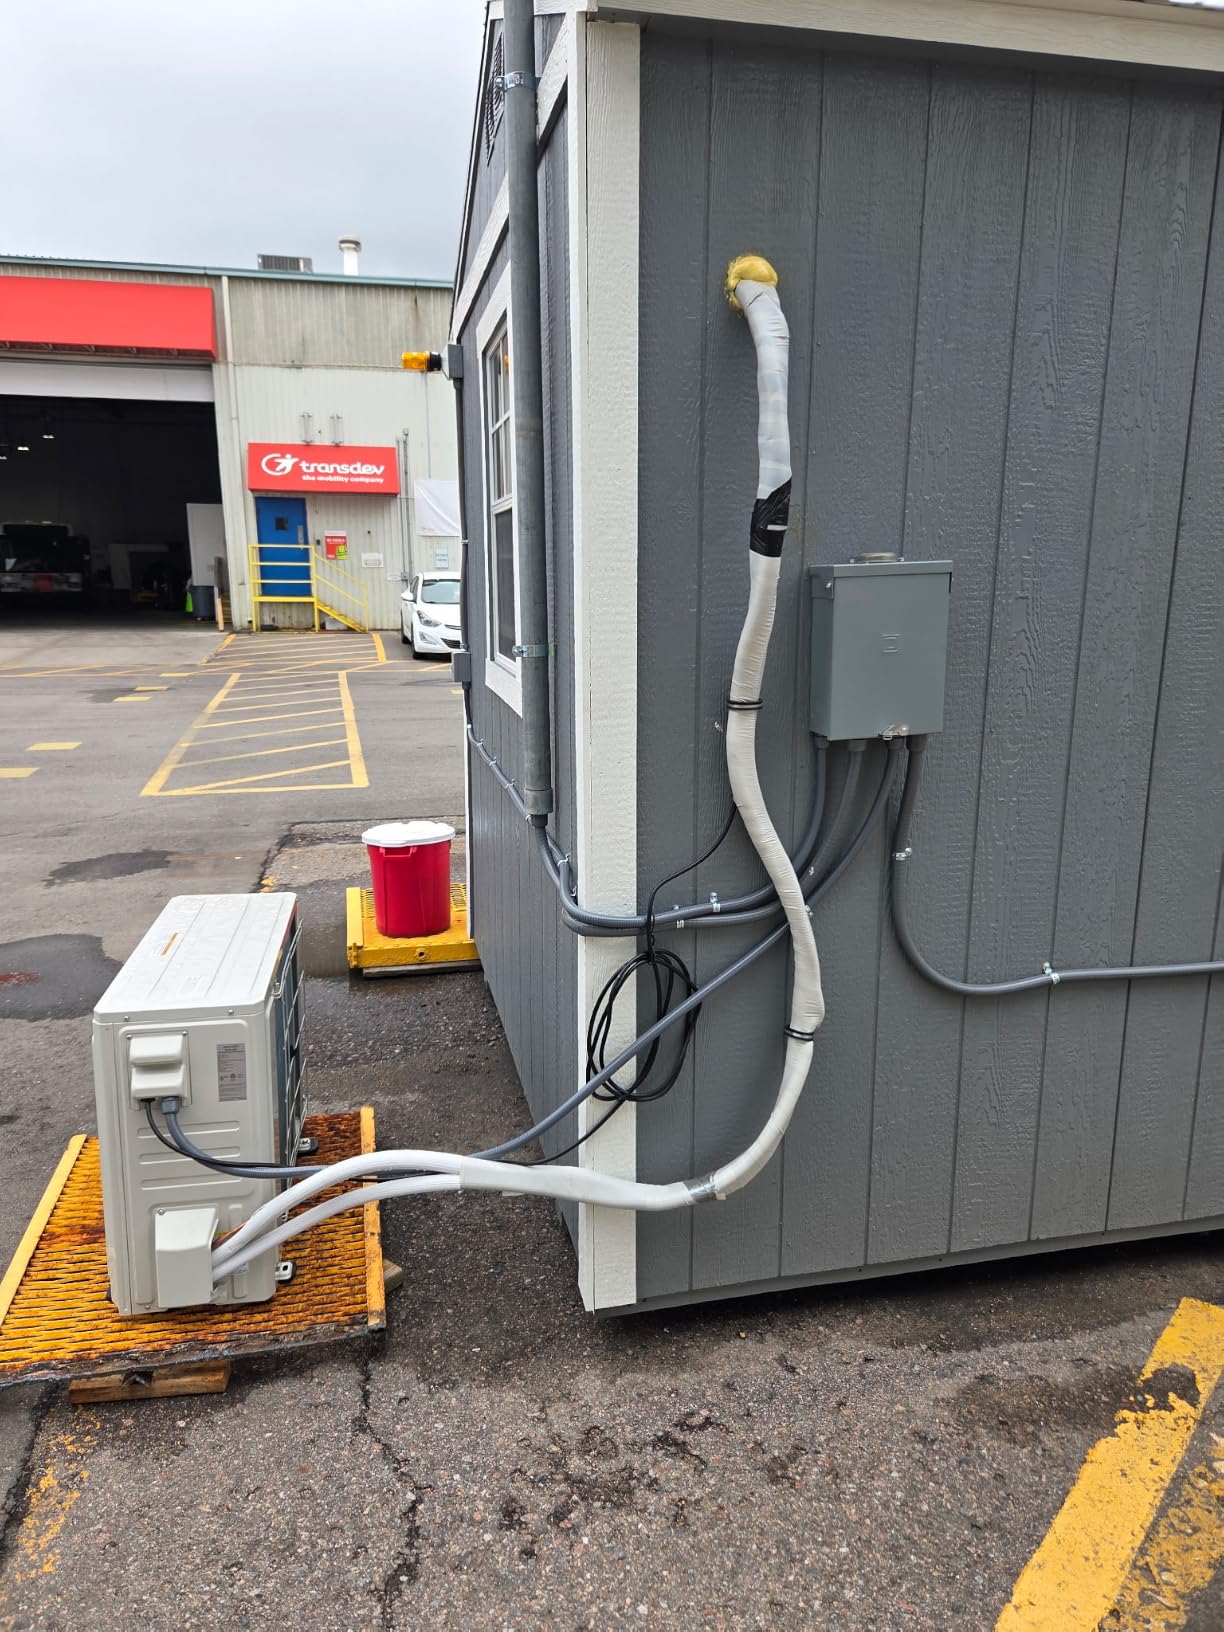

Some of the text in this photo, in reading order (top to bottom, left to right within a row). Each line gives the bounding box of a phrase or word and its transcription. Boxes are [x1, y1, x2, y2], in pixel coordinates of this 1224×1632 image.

[299, 461, 385, 475] transdev
[317, 475, 349, 483] mobility
[350, 476, 384, 484] company
